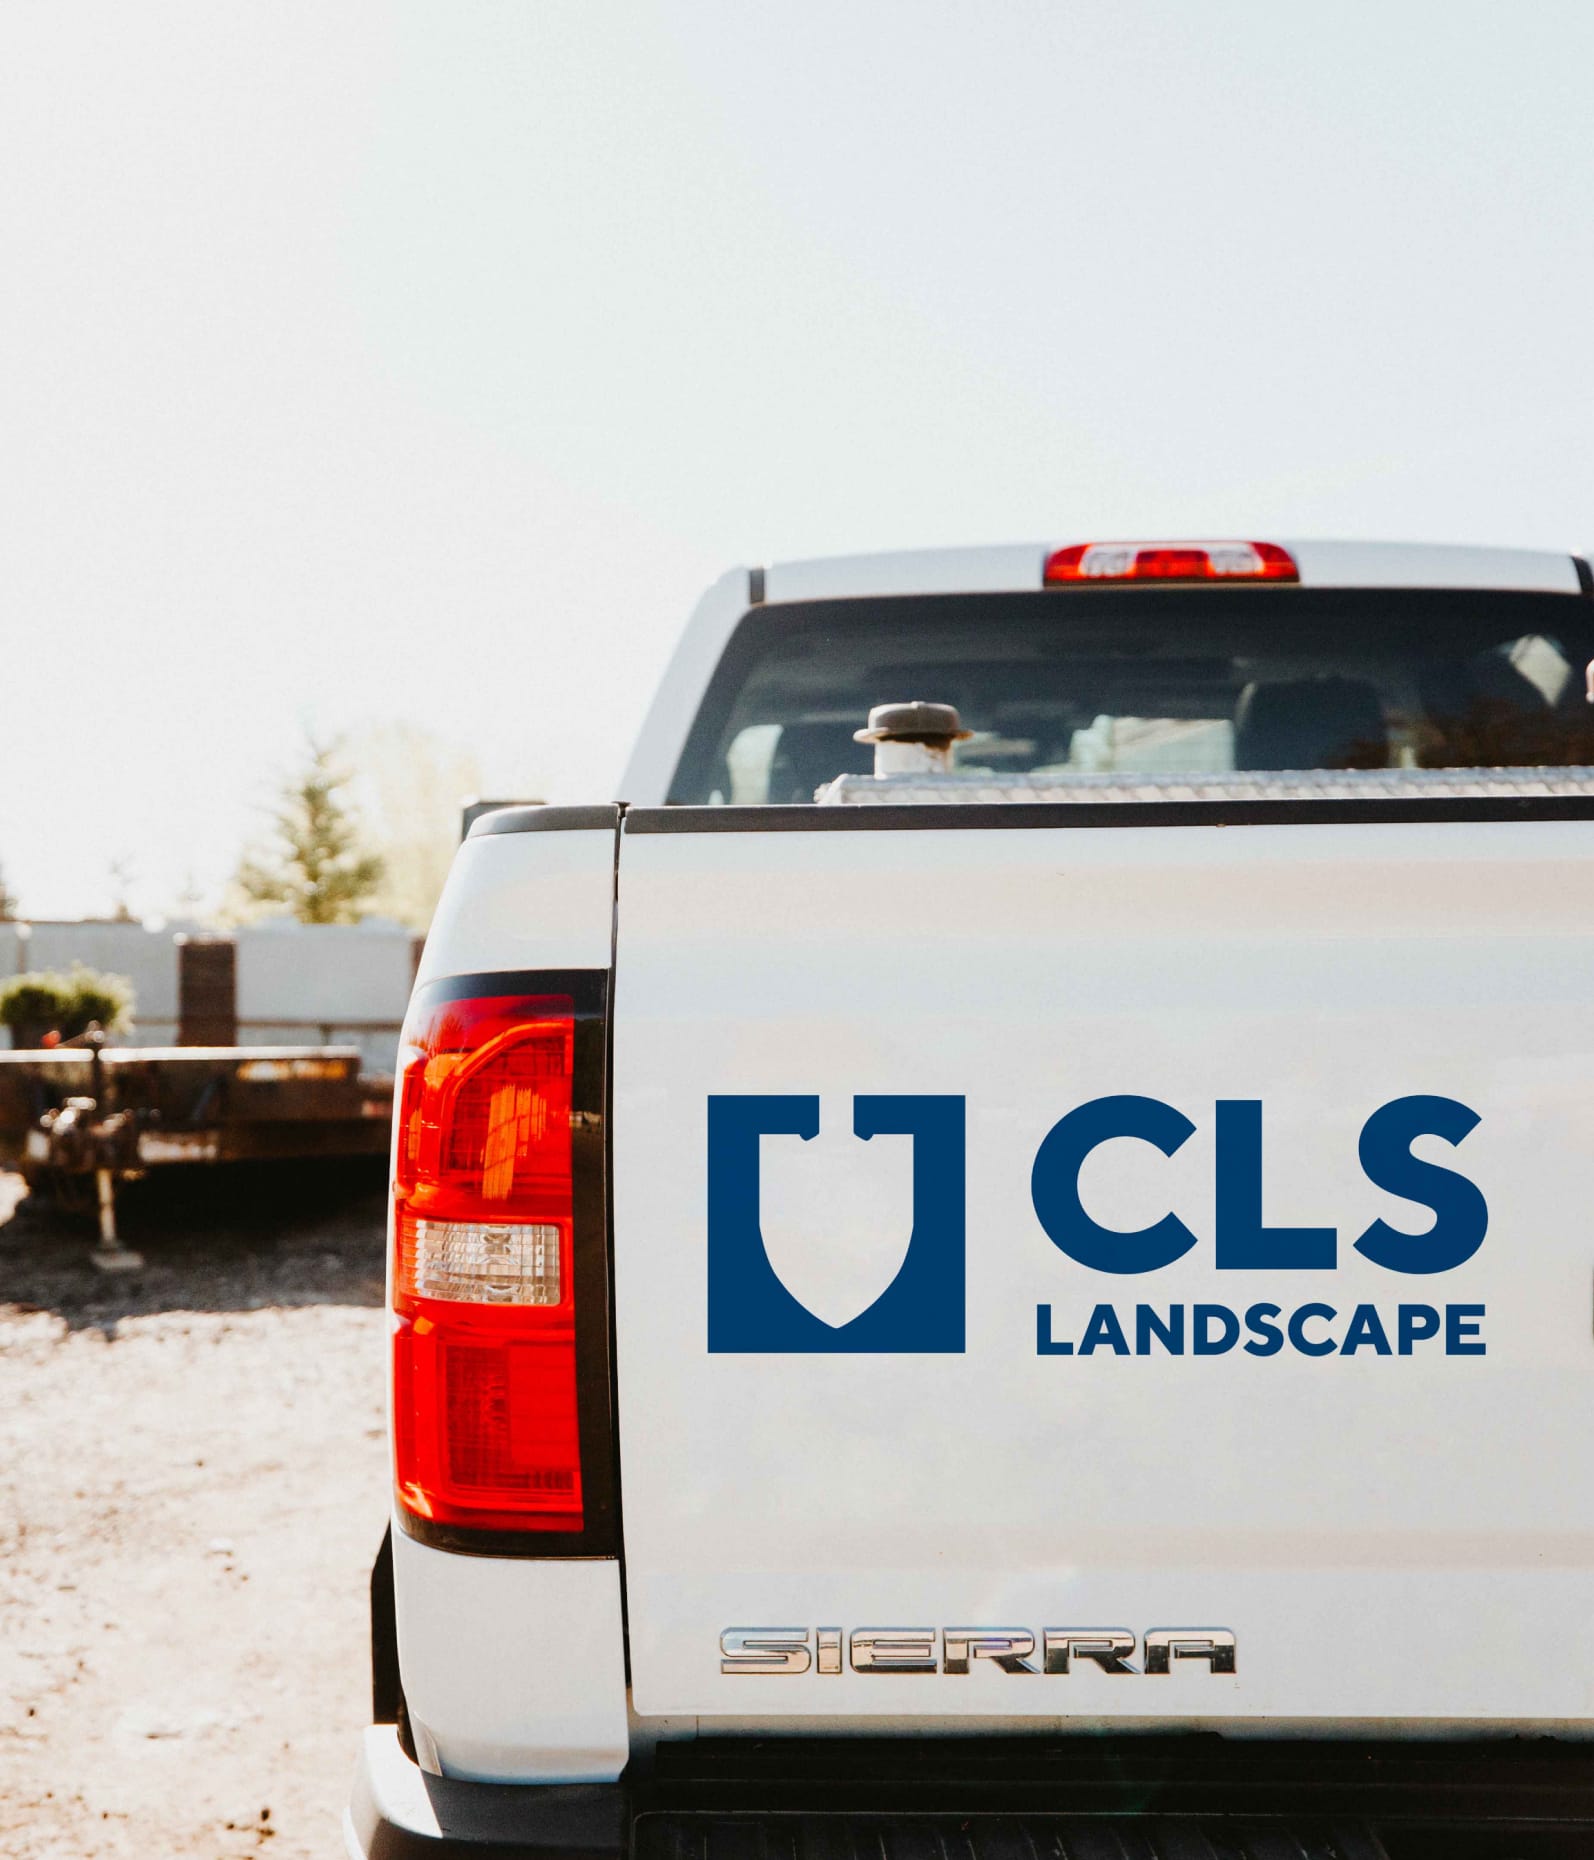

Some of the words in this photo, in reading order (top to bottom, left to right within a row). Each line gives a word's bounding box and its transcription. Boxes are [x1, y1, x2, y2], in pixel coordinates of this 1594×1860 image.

[1031, 1094, 1489, 1275] CLS
[1036, 1303, 1487, 1357] LANDSCAPE
[720, 1626, 1238, 1674] SIERRA
